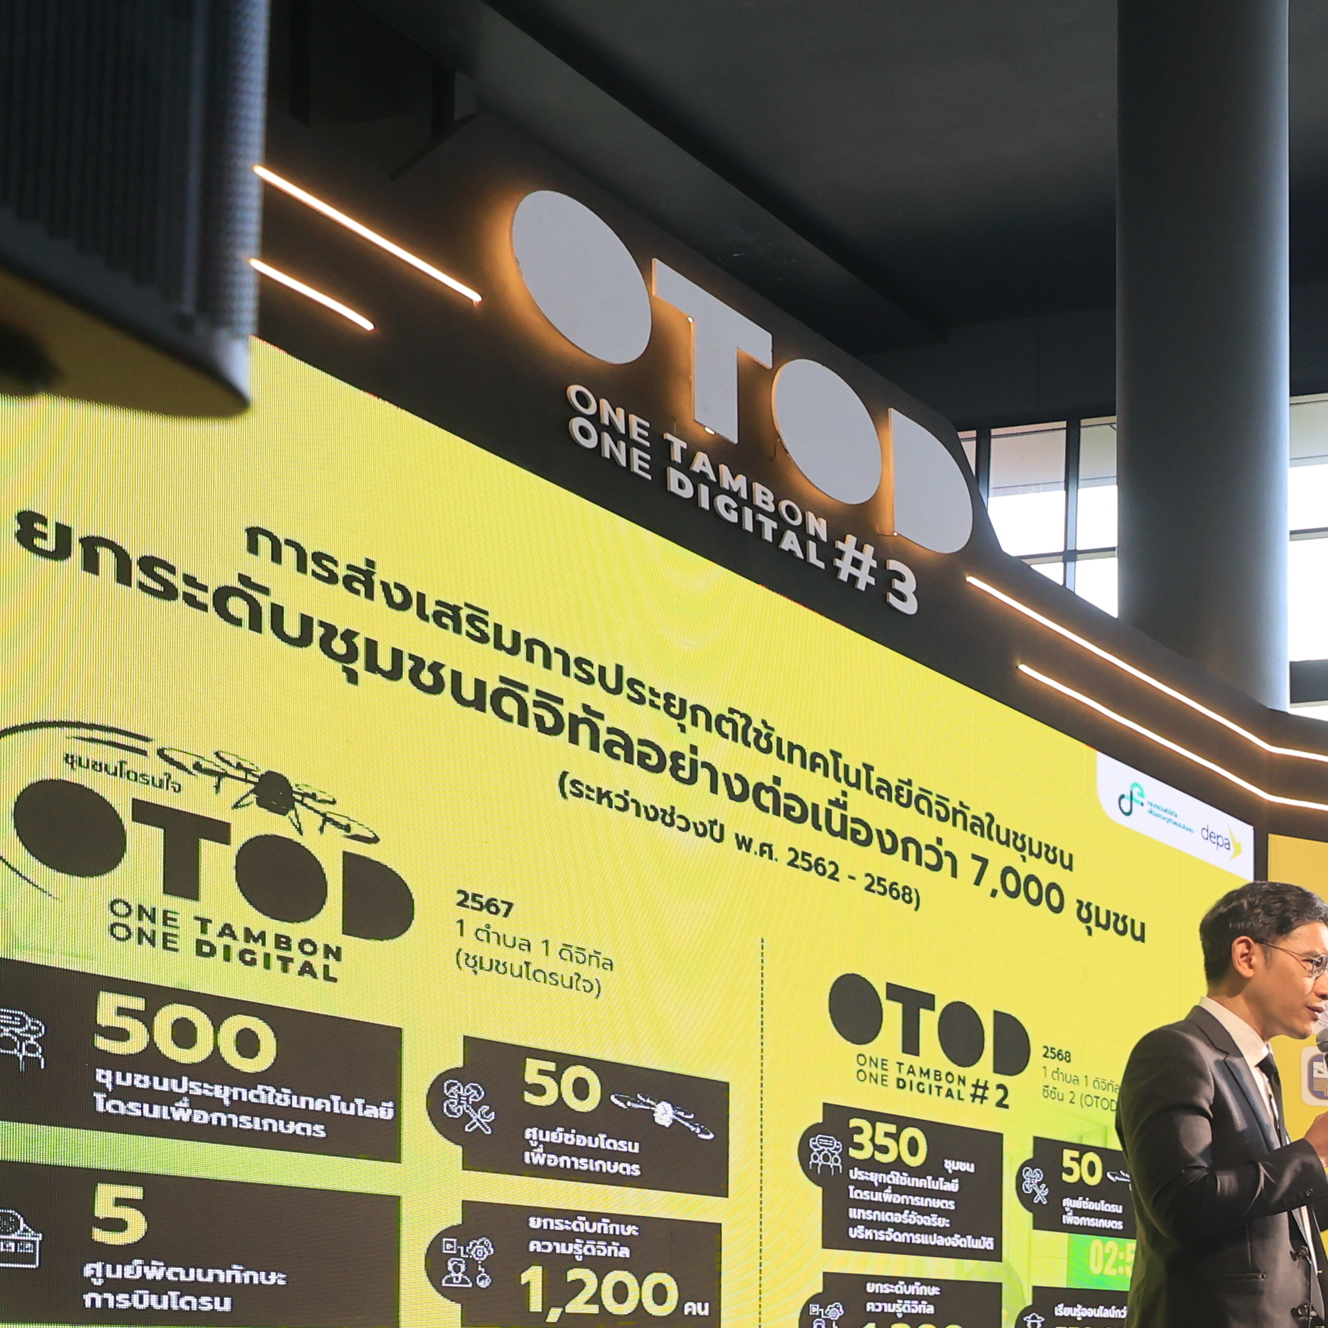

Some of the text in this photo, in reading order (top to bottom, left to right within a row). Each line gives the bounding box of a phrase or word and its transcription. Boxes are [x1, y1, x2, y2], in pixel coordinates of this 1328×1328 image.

[511, 189, 974, 555] OTOD
[567, 383, 829, 544] ONE TAMBON
[568, 417, 827, 570] ONE DIGITAL
[833, 534, 919, 616] #3
[245, 524, 1075, 872] การส่งเสริมการประยุกต์ใช้เทคโนโลยีดิจิทัลในชุมชน
[14, 510, 1146, 943] ยกระดับชุมชนดิจิทัลอย่างต่อเนื่องกว่า 7,000 ชุมชน
[64, 752, 182, 794] ชุมชนโดรนใจ
[558, 770, 725, 844] (ระหว่างช่วงปี
[734, 831, 778, 863] พ.ศ.
[786, 847, 840, 883] 2562
[863, 872, 922, 912] 2568)
[1200, 824, 1231, 851] depa
[13, 778, 415, 942] OTOD
[456, 889, 514, 920] 2567
[109, 898, 344, 963] ONE TAMBON
[456, 918, 615, 973] 1 ตำบล 1 ดิจิทัล
[109, 921, 340, 984] ONE DIGITAL
[455, 947, 602, 998] (ชุมชนโดรนใจ)
[93, 990, 279, 1075] 500
[827, 972, 1031, 1077] OTOD
[856, 1053, 966, 1087] ONE TAMBON
[1042, 1045, 1072, 1064] 2568
[94, 1066, 395, 1121] ชุมชนประยุกต์ใช้เทคโนโลยี
[522, 1057, 602, 1114] 50
[856, 1069, 965, 1102] ONE DIGITAL
[1042, 1066, 1048, 1078] 1
[1051, 1067, 1080, 1086] ตำบล
[1084, 1075, 1089, 1087] 1
[93, 1091, 327, 1139] โดรนเพื่อการเกษตร
[1069, 1090, 1076, 1105] 2
[523, 1126, 641, 1155] ศูนย์ซ่อมโดรน
[848, 1117, 928, 1168] 350
[523, 1144, 642, 1178] เพื่อการเกษตร
[848, 1167, 960, 1193] ประยุกต์ใช้เทคโนโลยี
[943, 1158, 975, 1174] ชุมชน
[1061, 1148, 1103, 1187] 50
[91, 1182, 148, 1246] 5
[848, 1185, 956, 1211] โดรนเพื่อการเกษตร
[1062, 1197, 1123, 1214] ศูนย์ซ่อมโดรน
[528, 1213, 640, 1238] ยกระดับทักษะ
[1062, 1209, 1124, 1230] เพื่อการเกษตร
[528, 1238, 631, 1262] ความรู้ดิจิทัล
[83, 1258, 287, 1286] ศูนย์พัฒนาทักษะ
[865, 1280, 941, 1296] ยกระดับทักษะ
[83, 1289, 233, 1313] การบินโดรน
[520, 1264, 710, 1323] 1,200 คน
[865, 1299, 935, 1319] ความรู้ดิจิทัล
[1054, 1303, 1128, 1321] เรียนรู้ออนไลน์กว่
